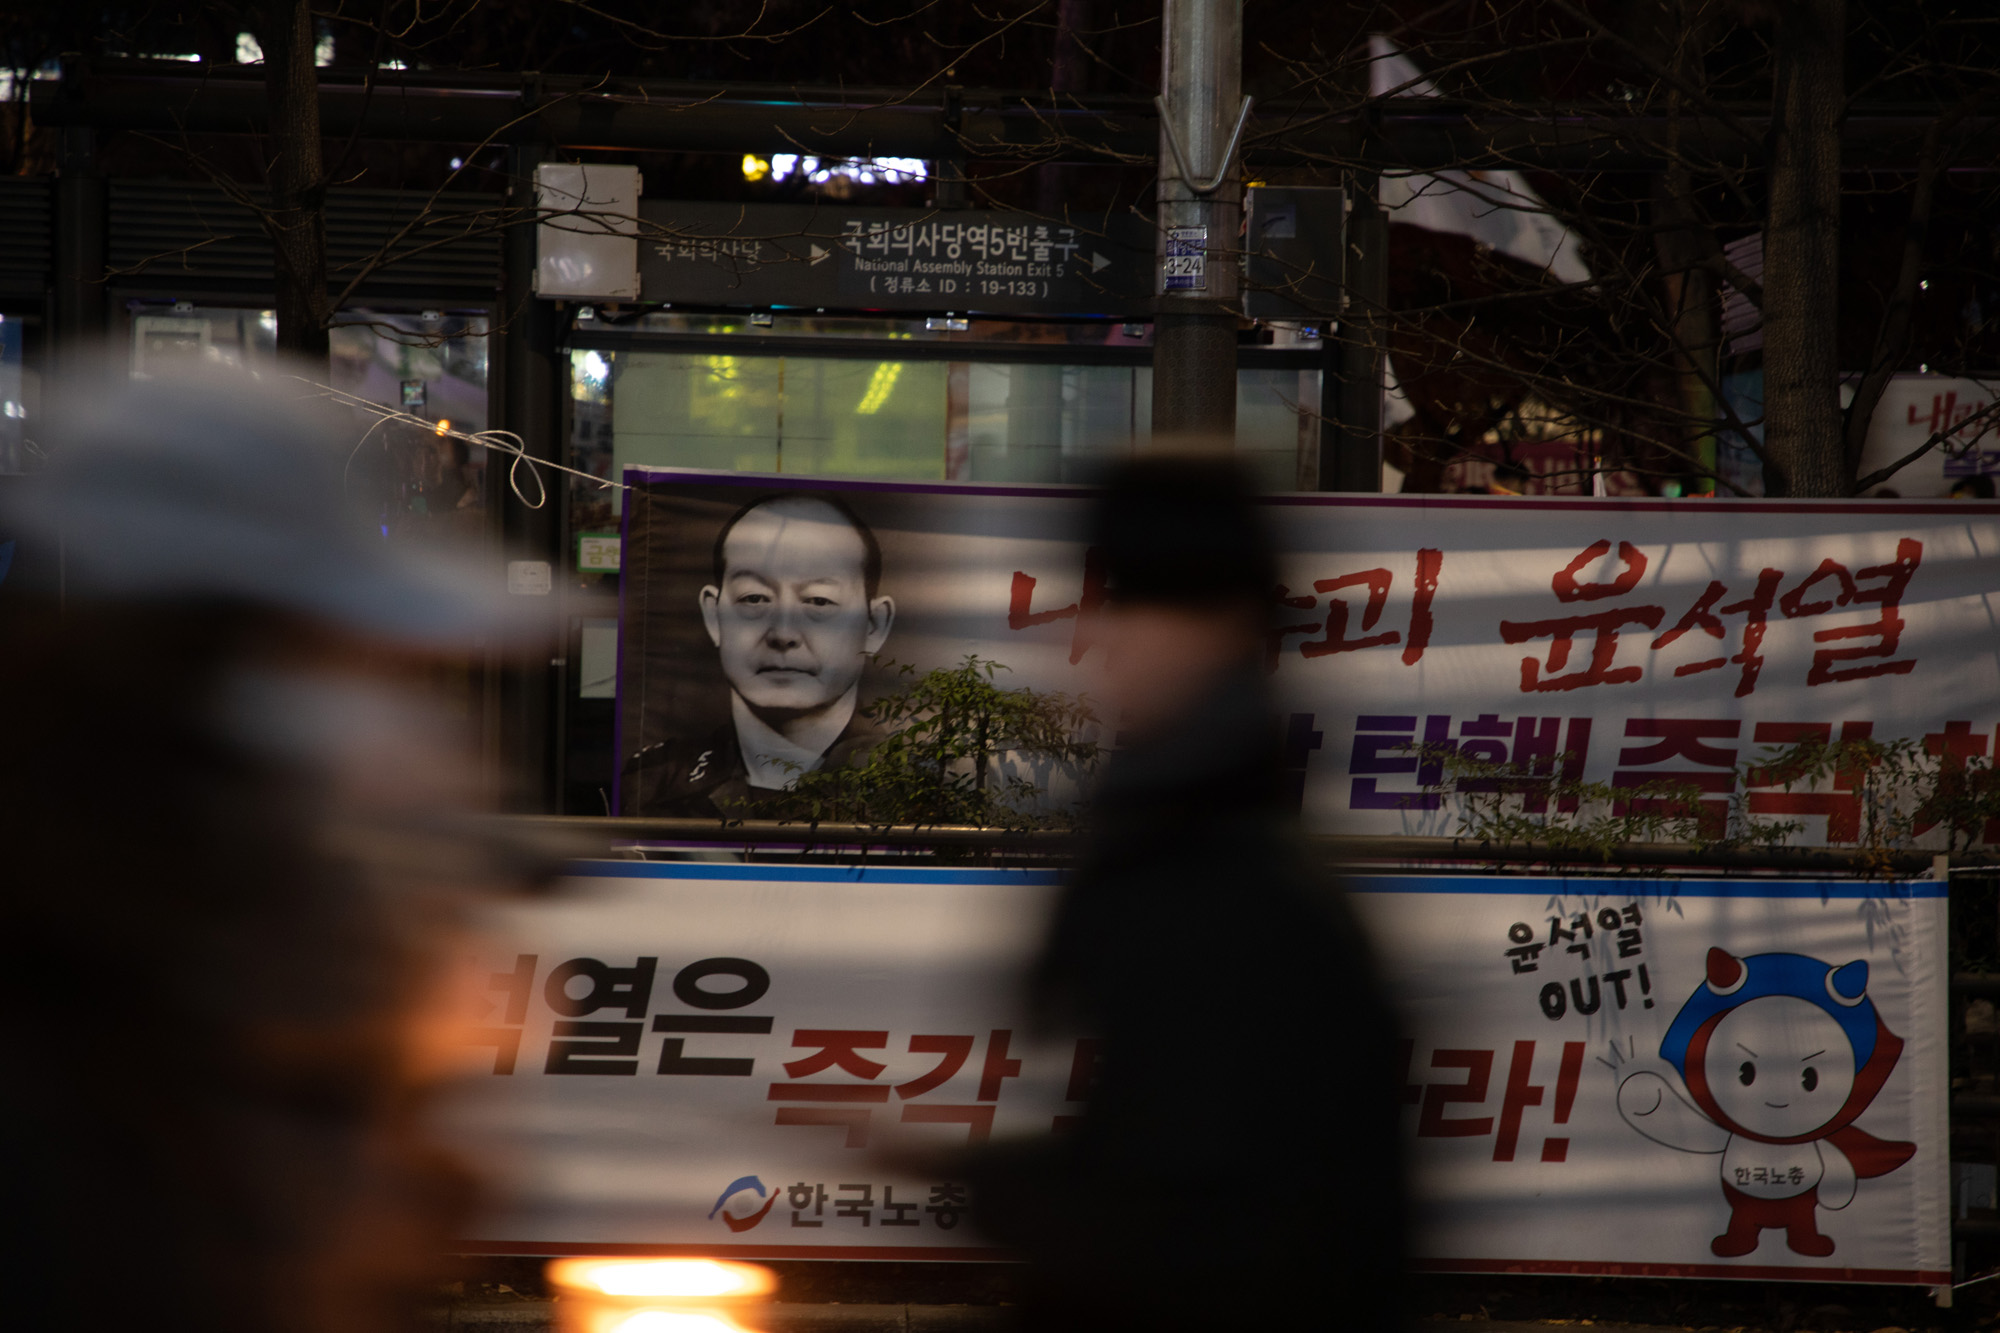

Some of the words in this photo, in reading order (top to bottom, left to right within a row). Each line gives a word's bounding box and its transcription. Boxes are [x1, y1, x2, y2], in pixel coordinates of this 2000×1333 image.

[841, 220, 1080, 263] 국회의사당역5번출구
[1168, 257, 1202, 275] 3-24
[854, 257, 908, 273] National
[912, 260, 972, 277] Assembly
[976, 262, 1023, 277] Station
[1027, 263, 1052, 278] Exit
[1056, 264, 1065, 278] 5
[883, 276, 932, 294] 정류소
[939, 279, 957, 294] ID
[979, 280, 1037, 296] 19-133
[1500, 538, 1923, 698] 윤석열
[1348, 713, 1593, 815] 탄핵
[1611, 718, 1882, 843] 즉각
[1504, 902, 1643, 975] 윤석열
[1538, 963, 1655, 1021] OUT!
[765, 1028, 1023, 1149] 즉각
[1734, 1166, 1805, 1186] 한국노총
[787, 1182, 969, 1231] 한국노총
